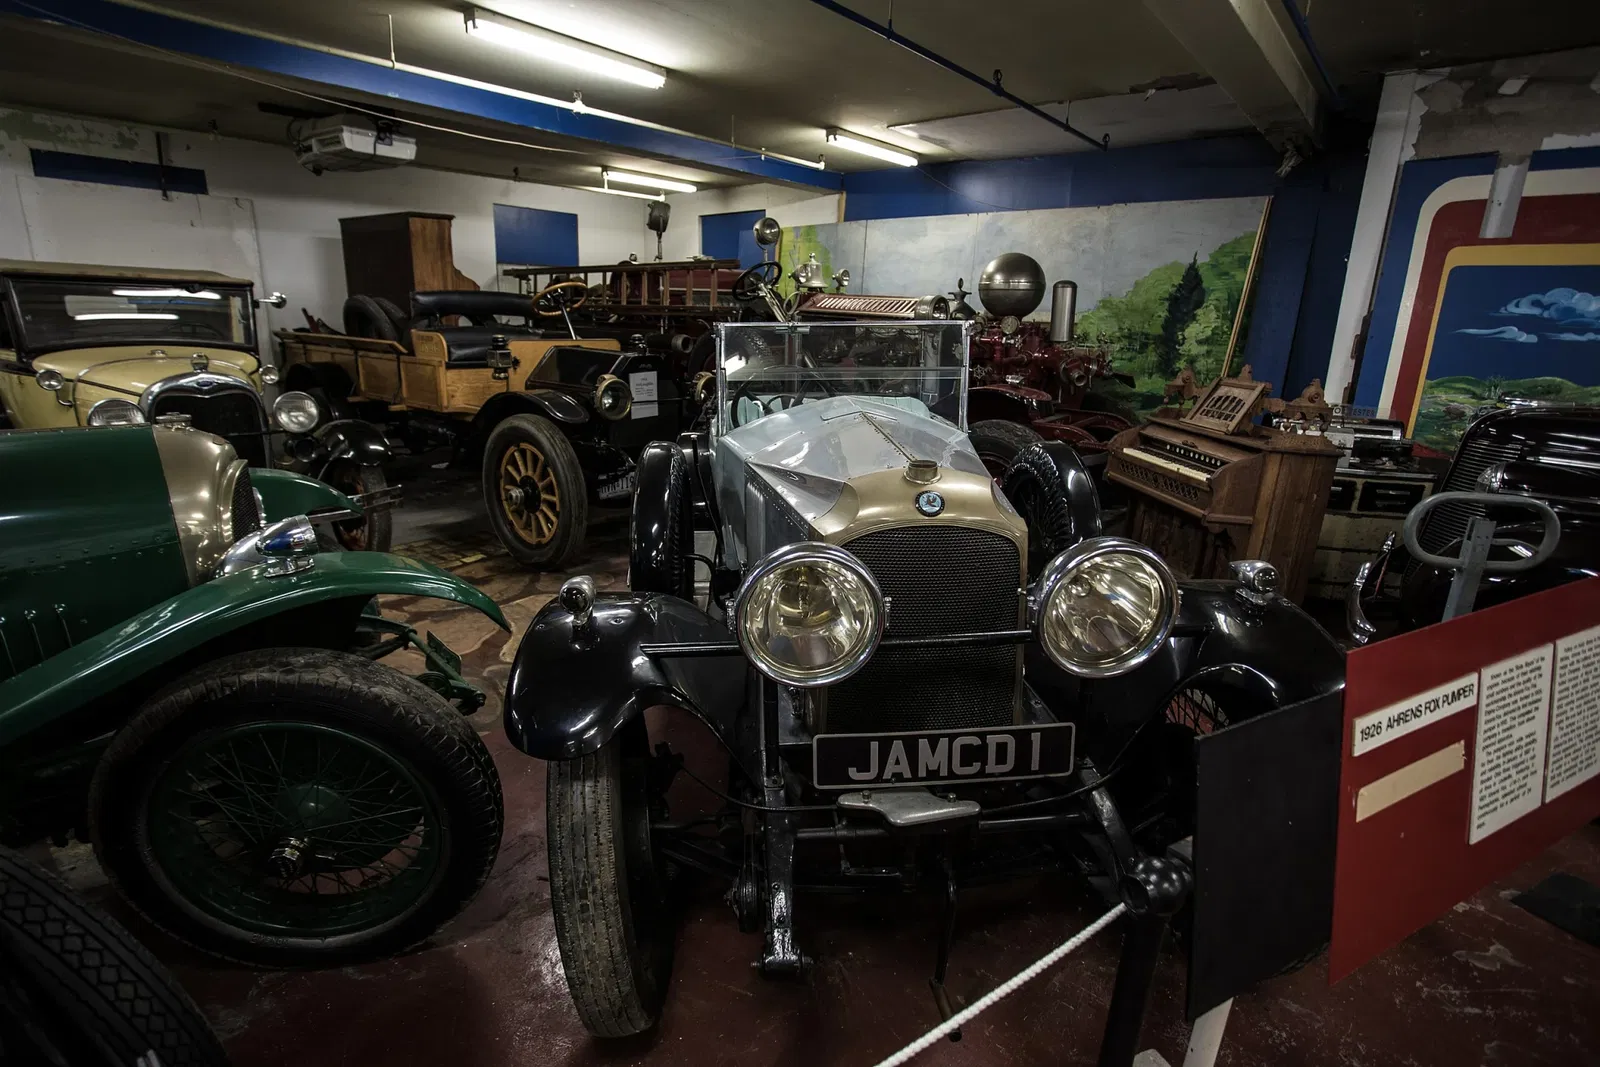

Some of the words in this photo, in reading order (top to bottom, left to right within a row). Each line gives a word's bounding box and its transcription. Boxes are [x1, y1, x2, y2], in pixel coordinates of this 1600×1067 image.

[1359, 721, 1382, 742] 1926
[1386, 704, 1423, 731] AHRENS
[1424, 698, 1442, 716] FOX
[1442, 684, 1474, 709] PUMPER
[848, 734, 1016, 781] JAMCD
[1030, 732, 1041, 771] 1
